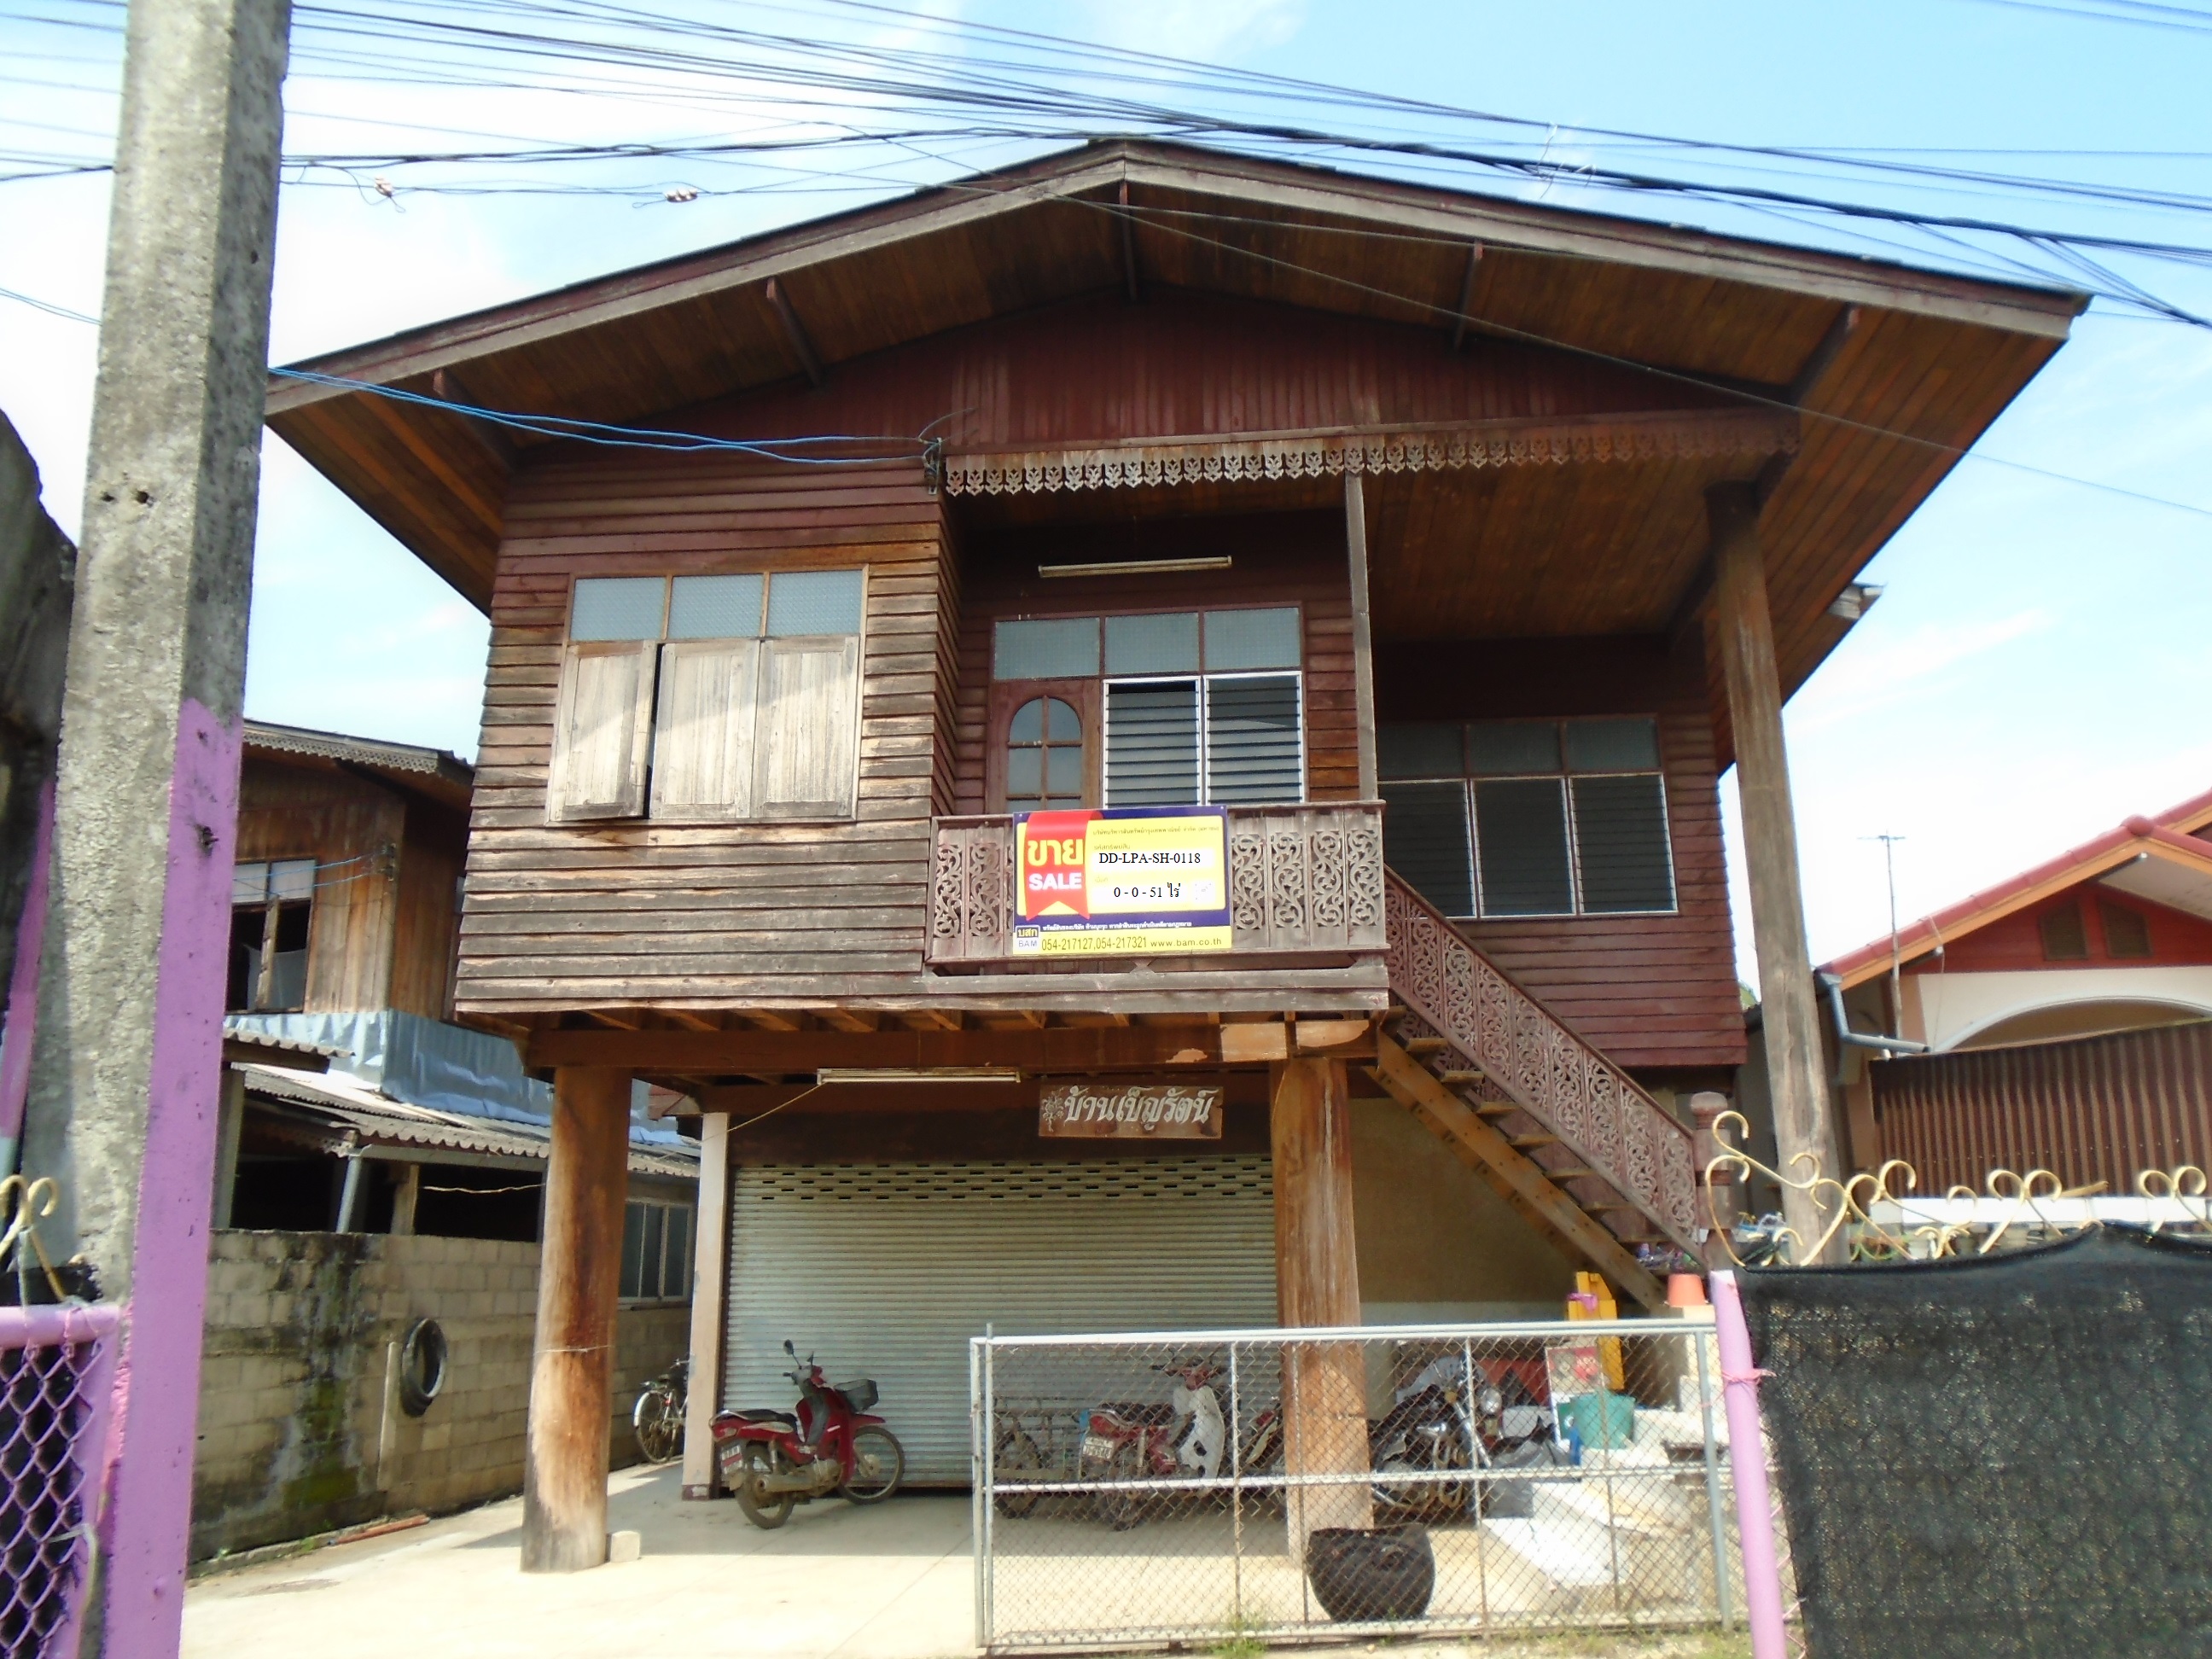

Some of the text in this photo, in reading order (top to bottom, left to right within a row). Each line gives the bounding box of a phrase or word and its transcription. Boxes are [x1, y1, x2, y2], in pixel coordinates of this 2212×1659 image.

[1027, 839, 1084, 866] ขาย
[1028, 872, 1082, 891] SALE
[1017, 928, 1038, 937] บสก
[1041, 936, 1222, 951] 054-217127,054-217321 www.bam.co.th
